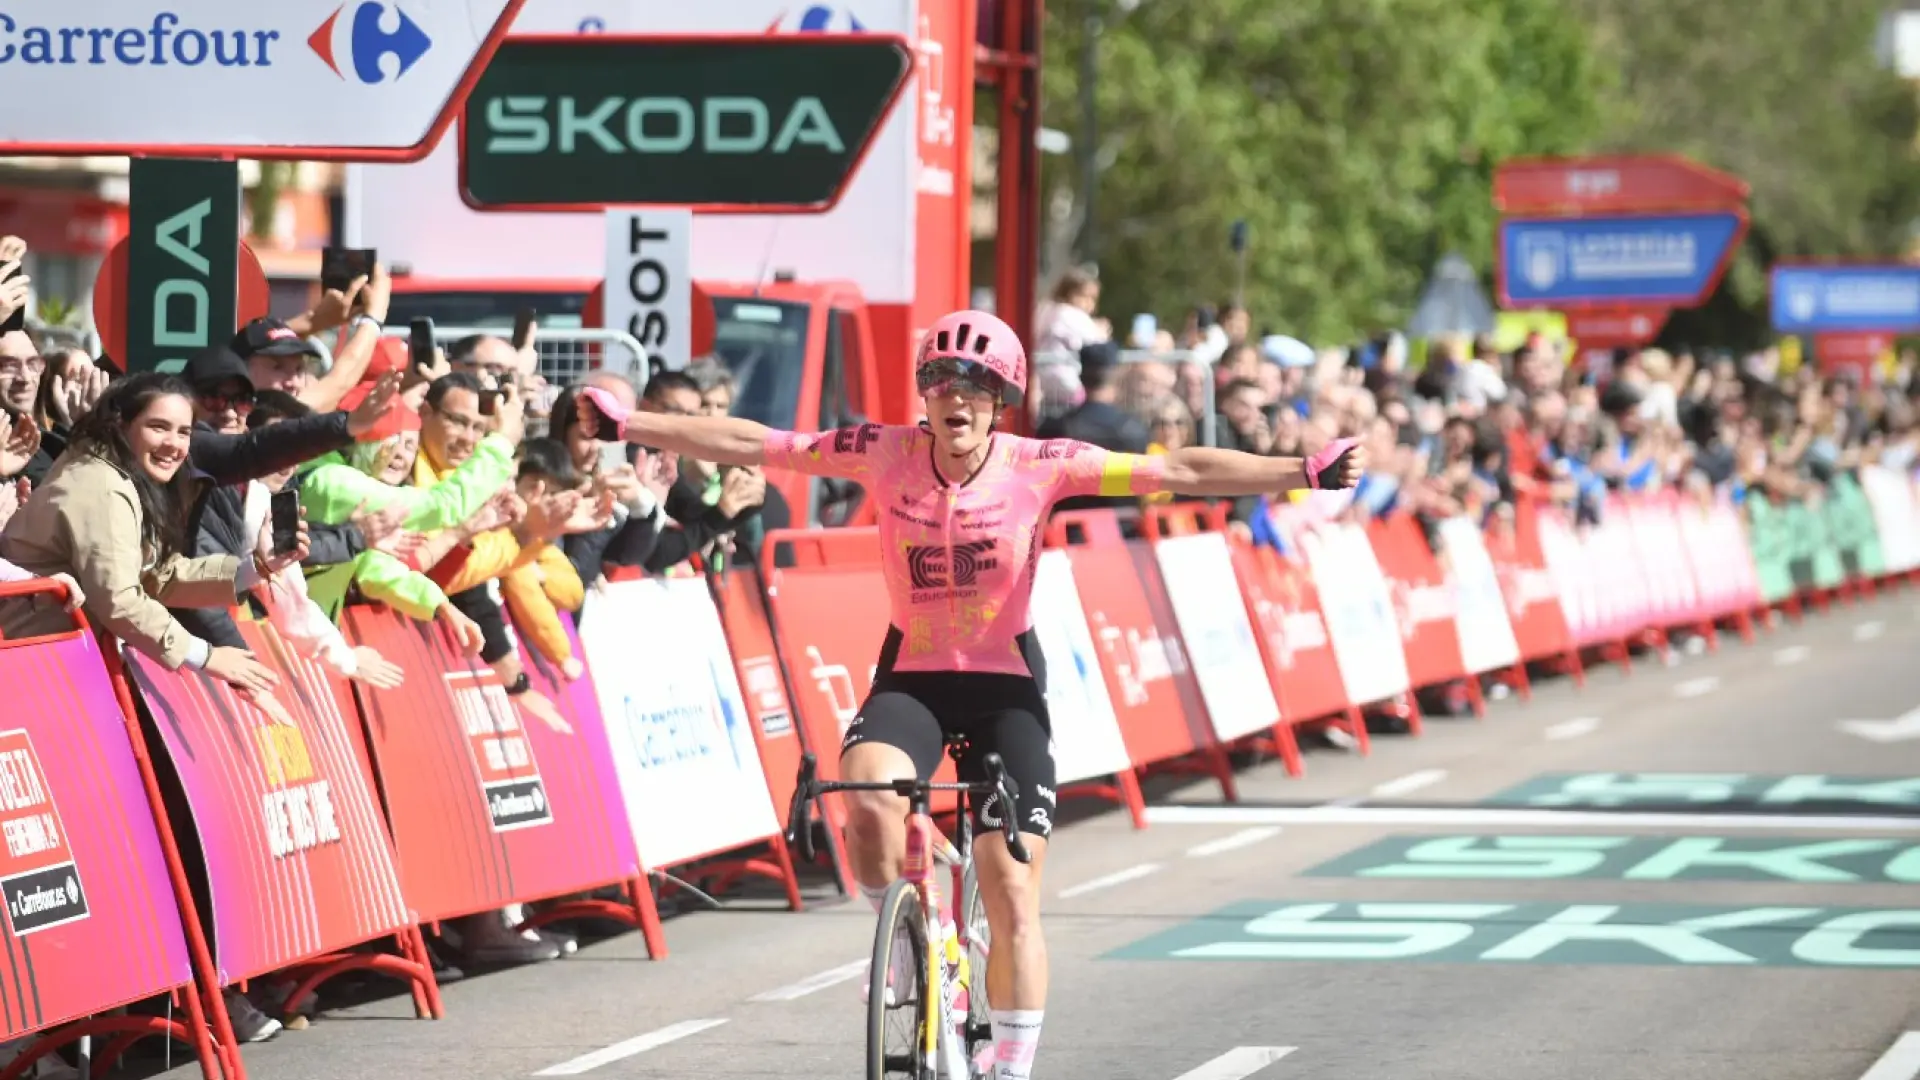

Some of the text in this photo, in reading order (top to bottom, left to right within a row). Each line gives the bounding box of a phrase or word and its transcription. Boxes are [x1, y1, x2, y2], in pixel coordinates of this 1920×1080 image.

[153, 198, 211, 374] DA
[911, 589, 977, 604] Educaion
[1355, 836, 1920, 882] SK
